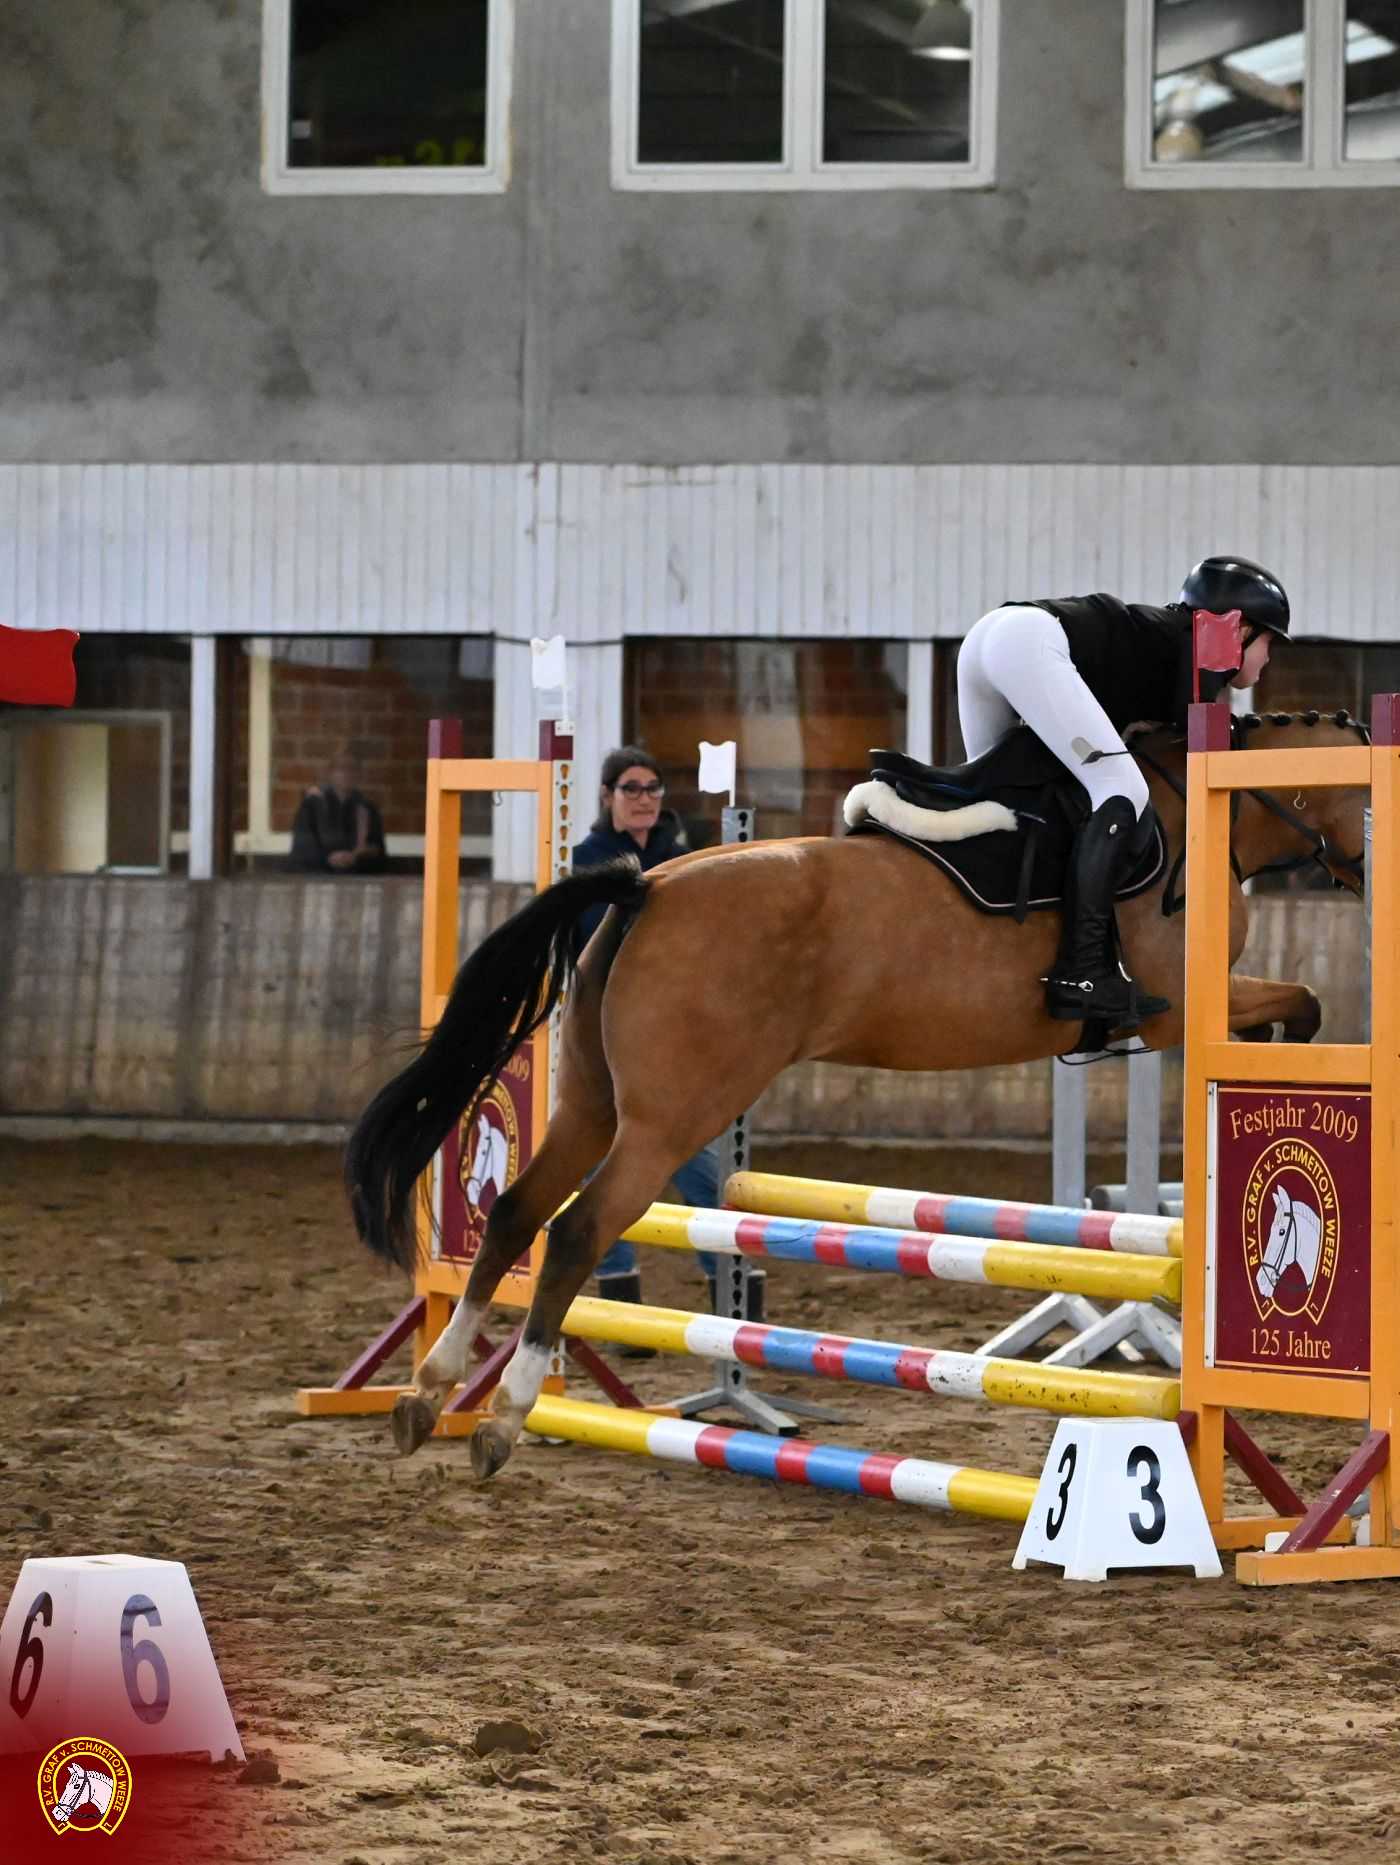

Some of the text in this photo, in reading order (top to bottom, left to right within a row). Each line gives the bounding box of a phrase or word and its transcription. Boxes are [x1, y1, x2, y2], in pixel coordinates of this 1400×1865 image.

[1230, 1098, 1358, 1143] Festjahr 2009
[1246, 1170, 1264, 1223] GRAF
[1275, 1144, 1335, 1209] SCHMETTOW
[1320, 1219, 1336, 1278] WEEZE
[1251, 1328, 1332, 1360] 125 Jahre
[1046, 1443, 1077, 1541] 3
[1126, 1445, 1166, 1545] 3
[9, 1591, 53, 1720] 6
[120, 1594, 170, 1725] 6
